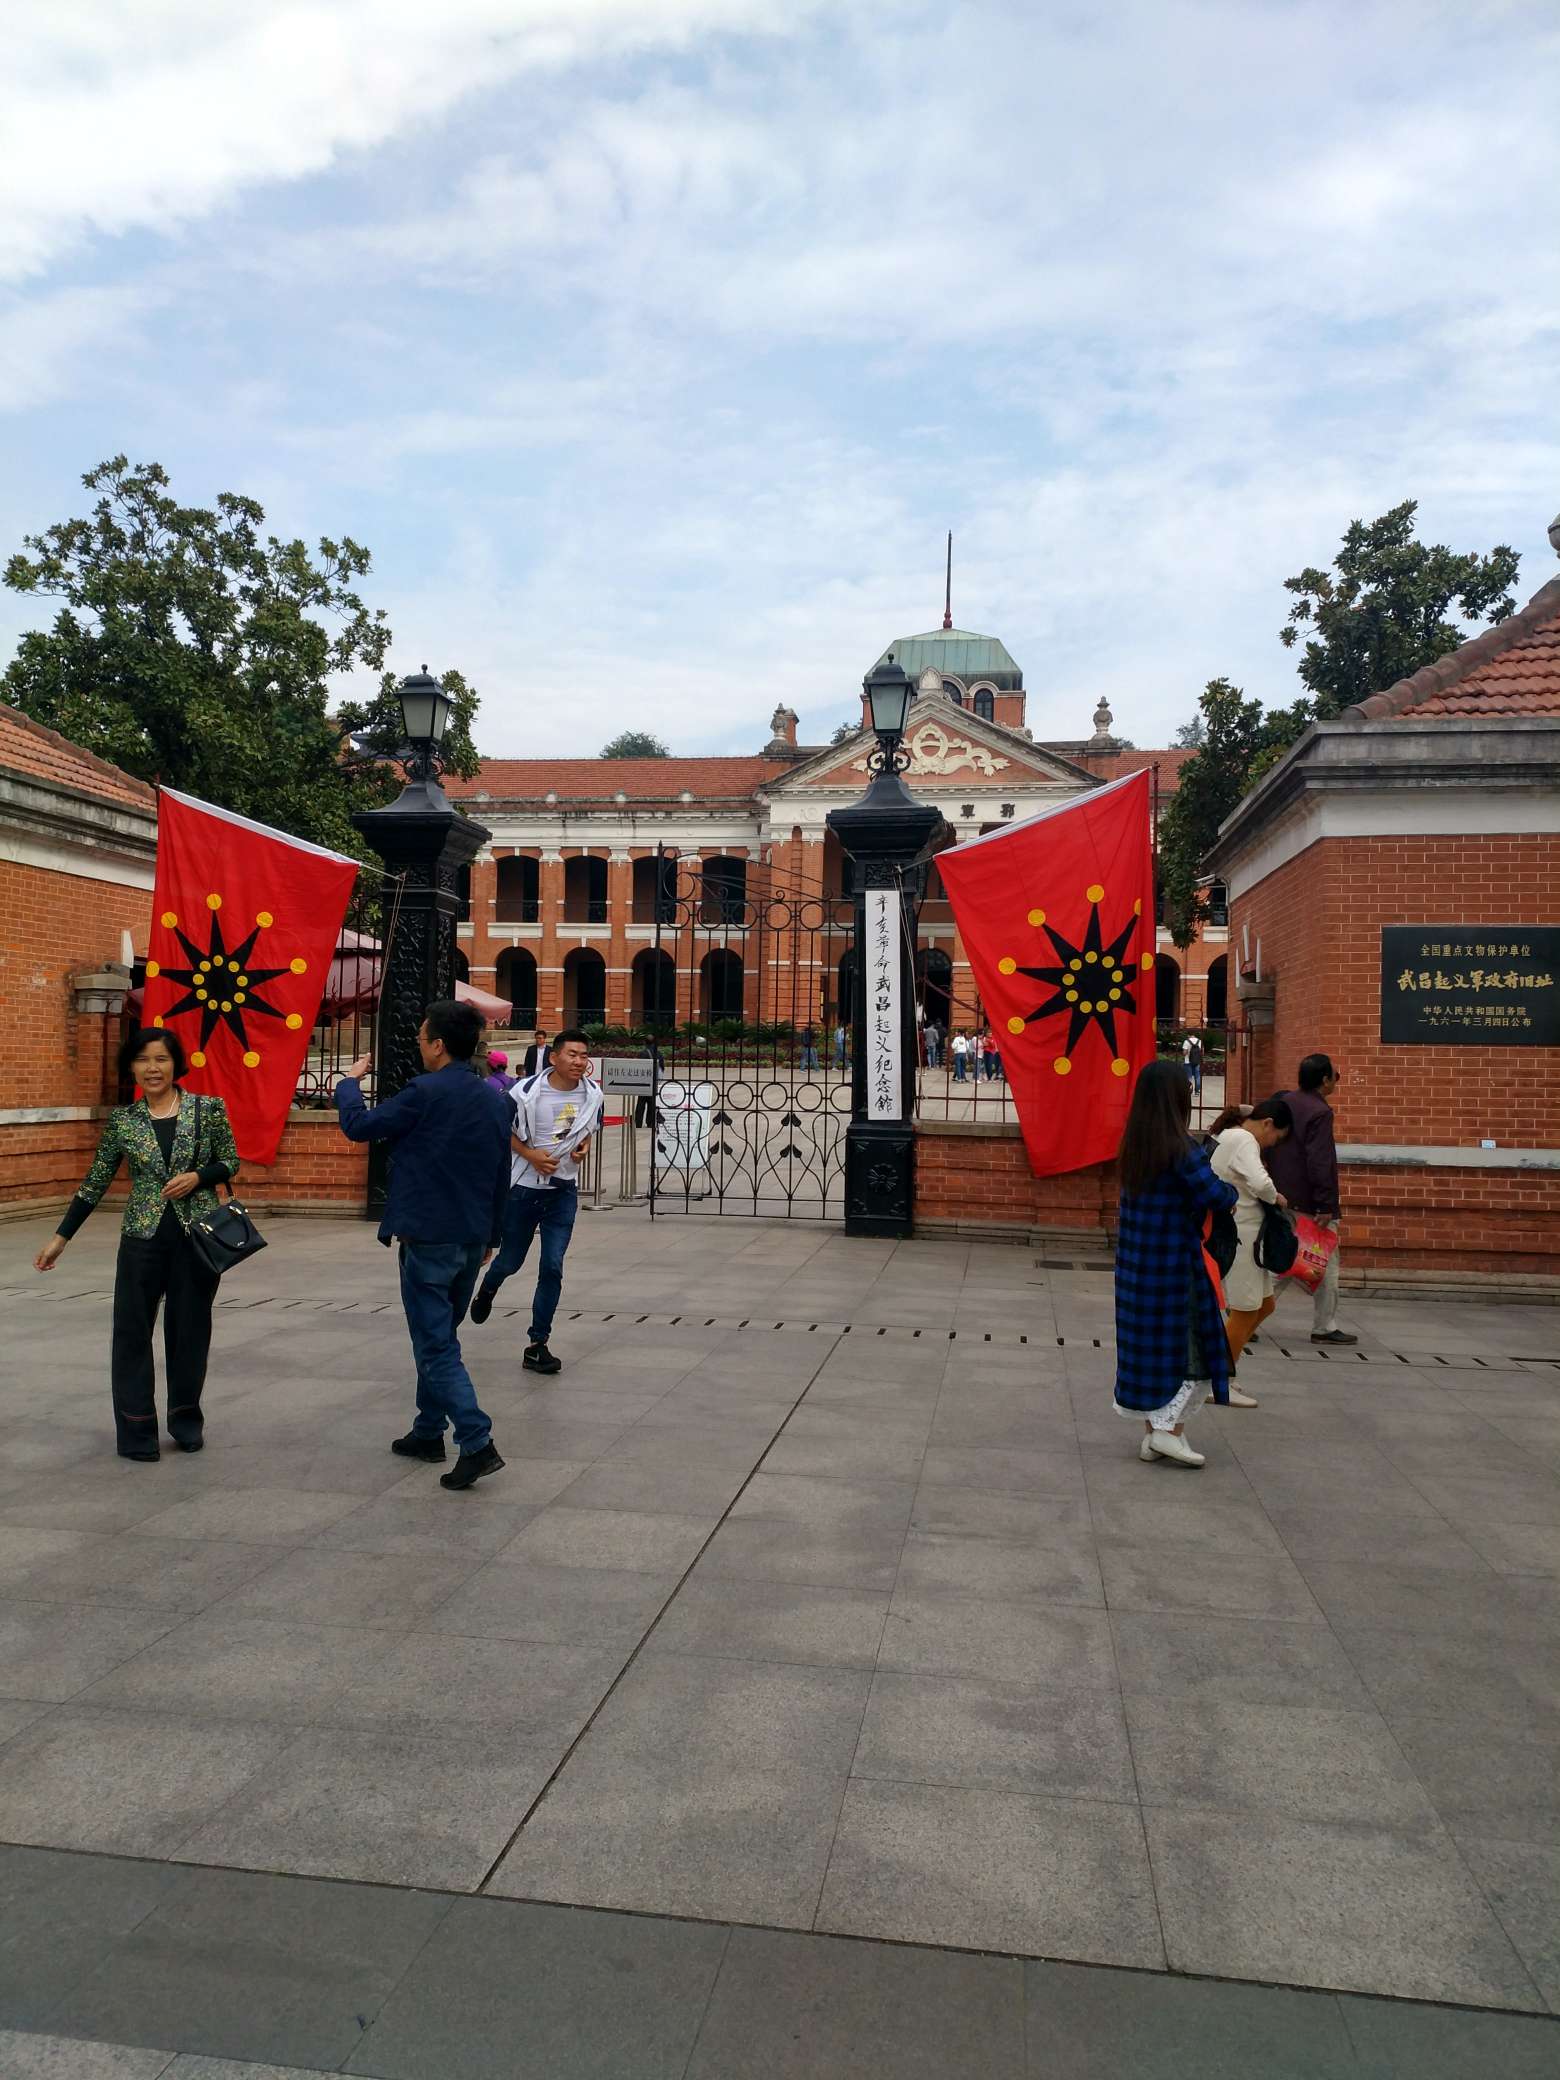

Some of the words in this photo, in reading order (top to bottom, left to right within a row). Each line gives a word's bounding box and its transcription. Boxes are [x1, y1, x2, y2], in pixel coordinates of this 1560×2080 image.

[1420, 944, 1531, 957] 全国重点文物保护单位
[1423, 1006, 1526, 1016] 中华人民共和国国务院
[1418, 1017, 1532, 1027] 一九六一年三月四日公布
